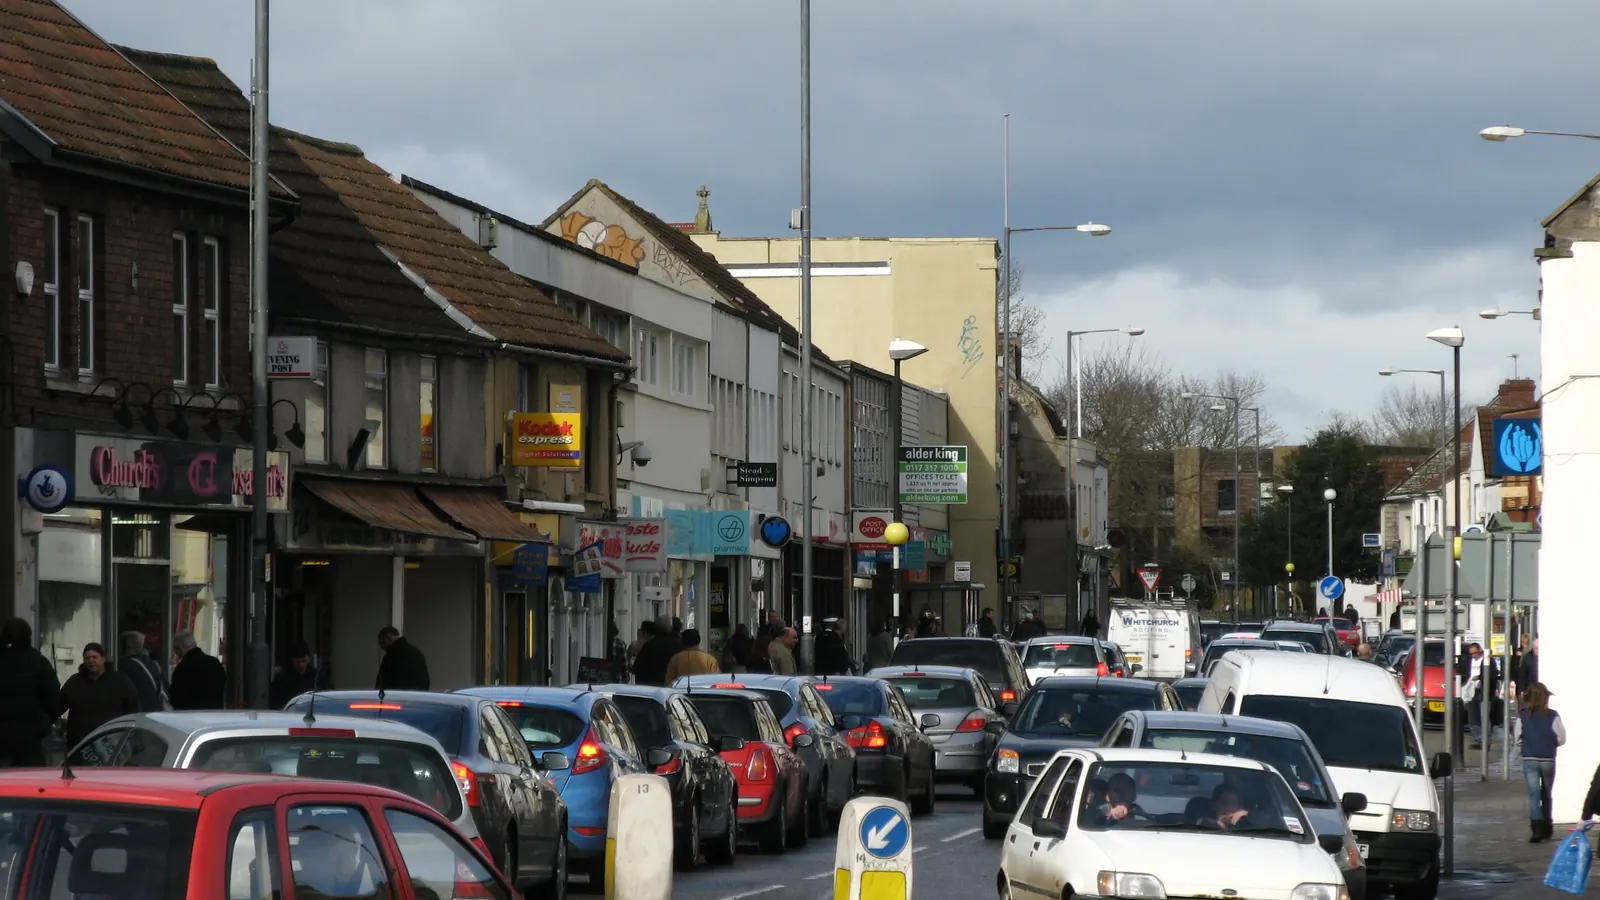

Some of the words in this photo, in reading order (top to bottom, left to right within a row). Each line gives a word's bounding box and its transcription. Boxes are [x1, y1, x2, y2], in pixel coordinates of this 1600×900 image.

[268, 355, 300, 364] VENING
[271, 364, 293, 373] POST
[518, 420, 574, 436] Kodak
[518, 434, 574, 445] express
[519, 451, 541, 459] Digital
[740, 466, 762, 474] Stead
[905, 464, 923, 472] 0117
[924, 464, 938, 472] 317
[740, 475, 774, 483] Simpson
[905, 494, 959, 502] alderking.com
[626, 522, 660, 536] aste
[713, 545, 749, 553] pharmacy
[1123, 617, 1179, 626] WHITCHURCH
[637, 783, 650, 794] 13
